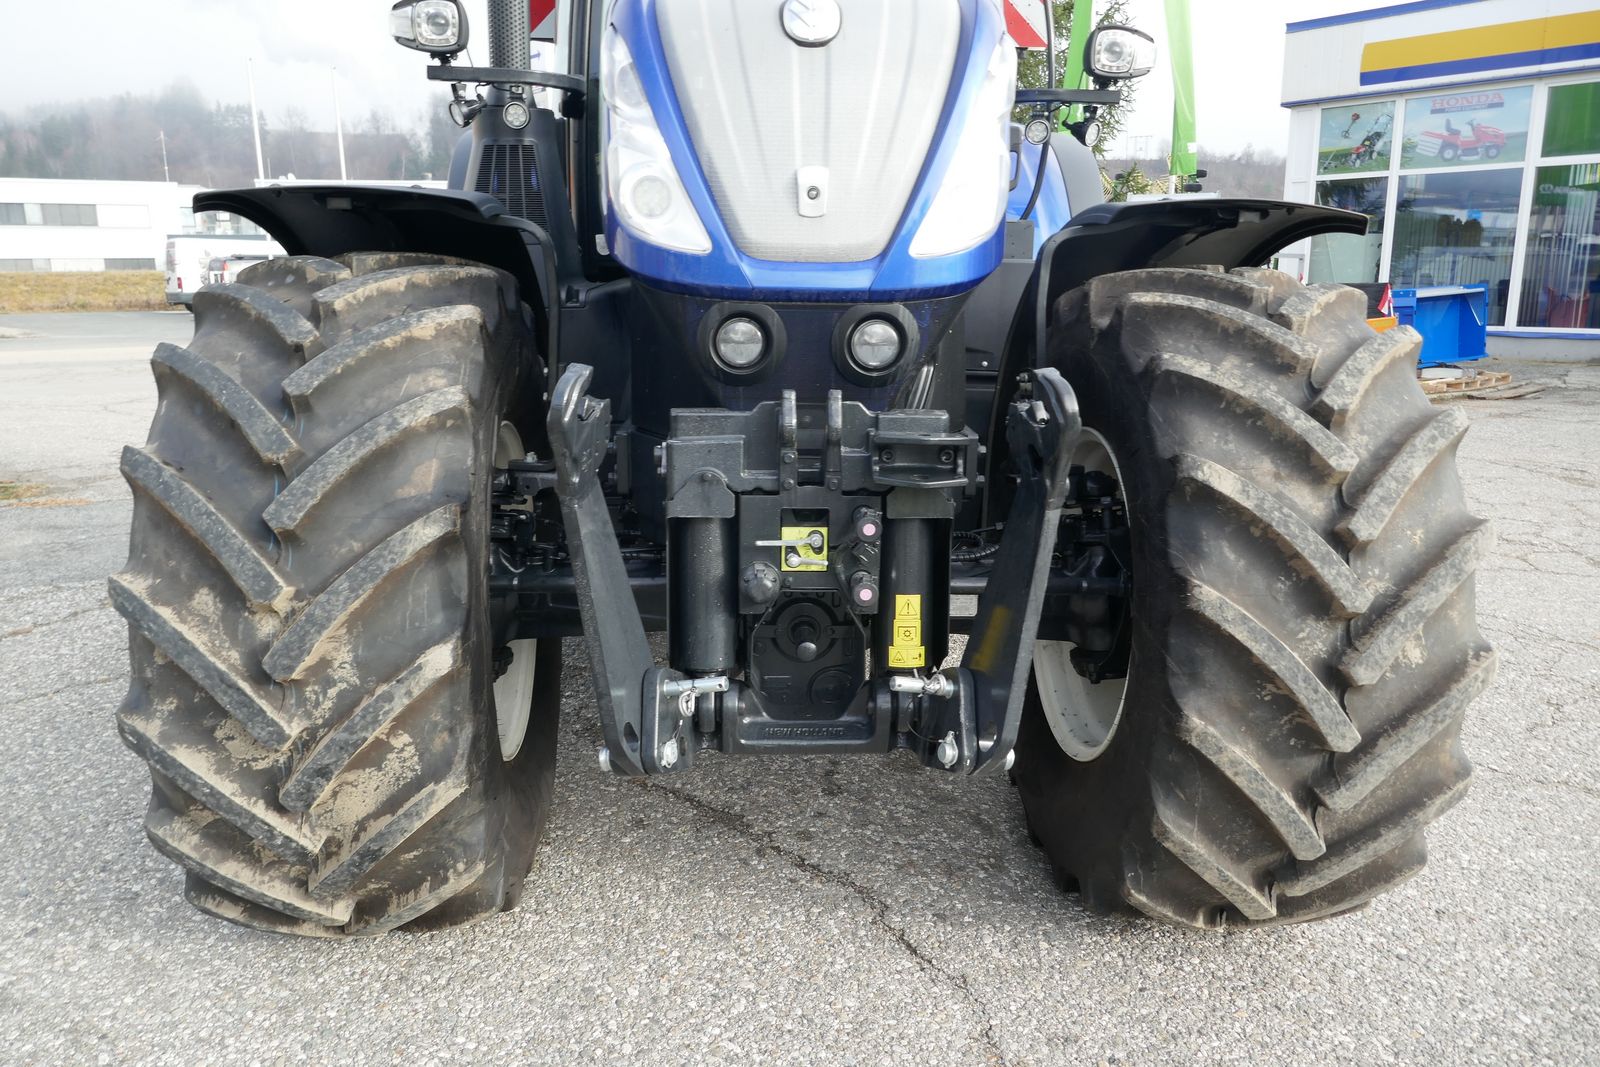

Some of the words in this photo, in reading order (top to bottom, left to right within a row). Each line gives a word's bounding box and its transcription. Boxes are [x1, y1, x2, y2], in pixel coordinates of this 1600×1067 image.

[1432, 92, 1503, 108] HONDA
[765, 727, 791, 736] NEW
[793, 727, 845, 736] HOLLAND
